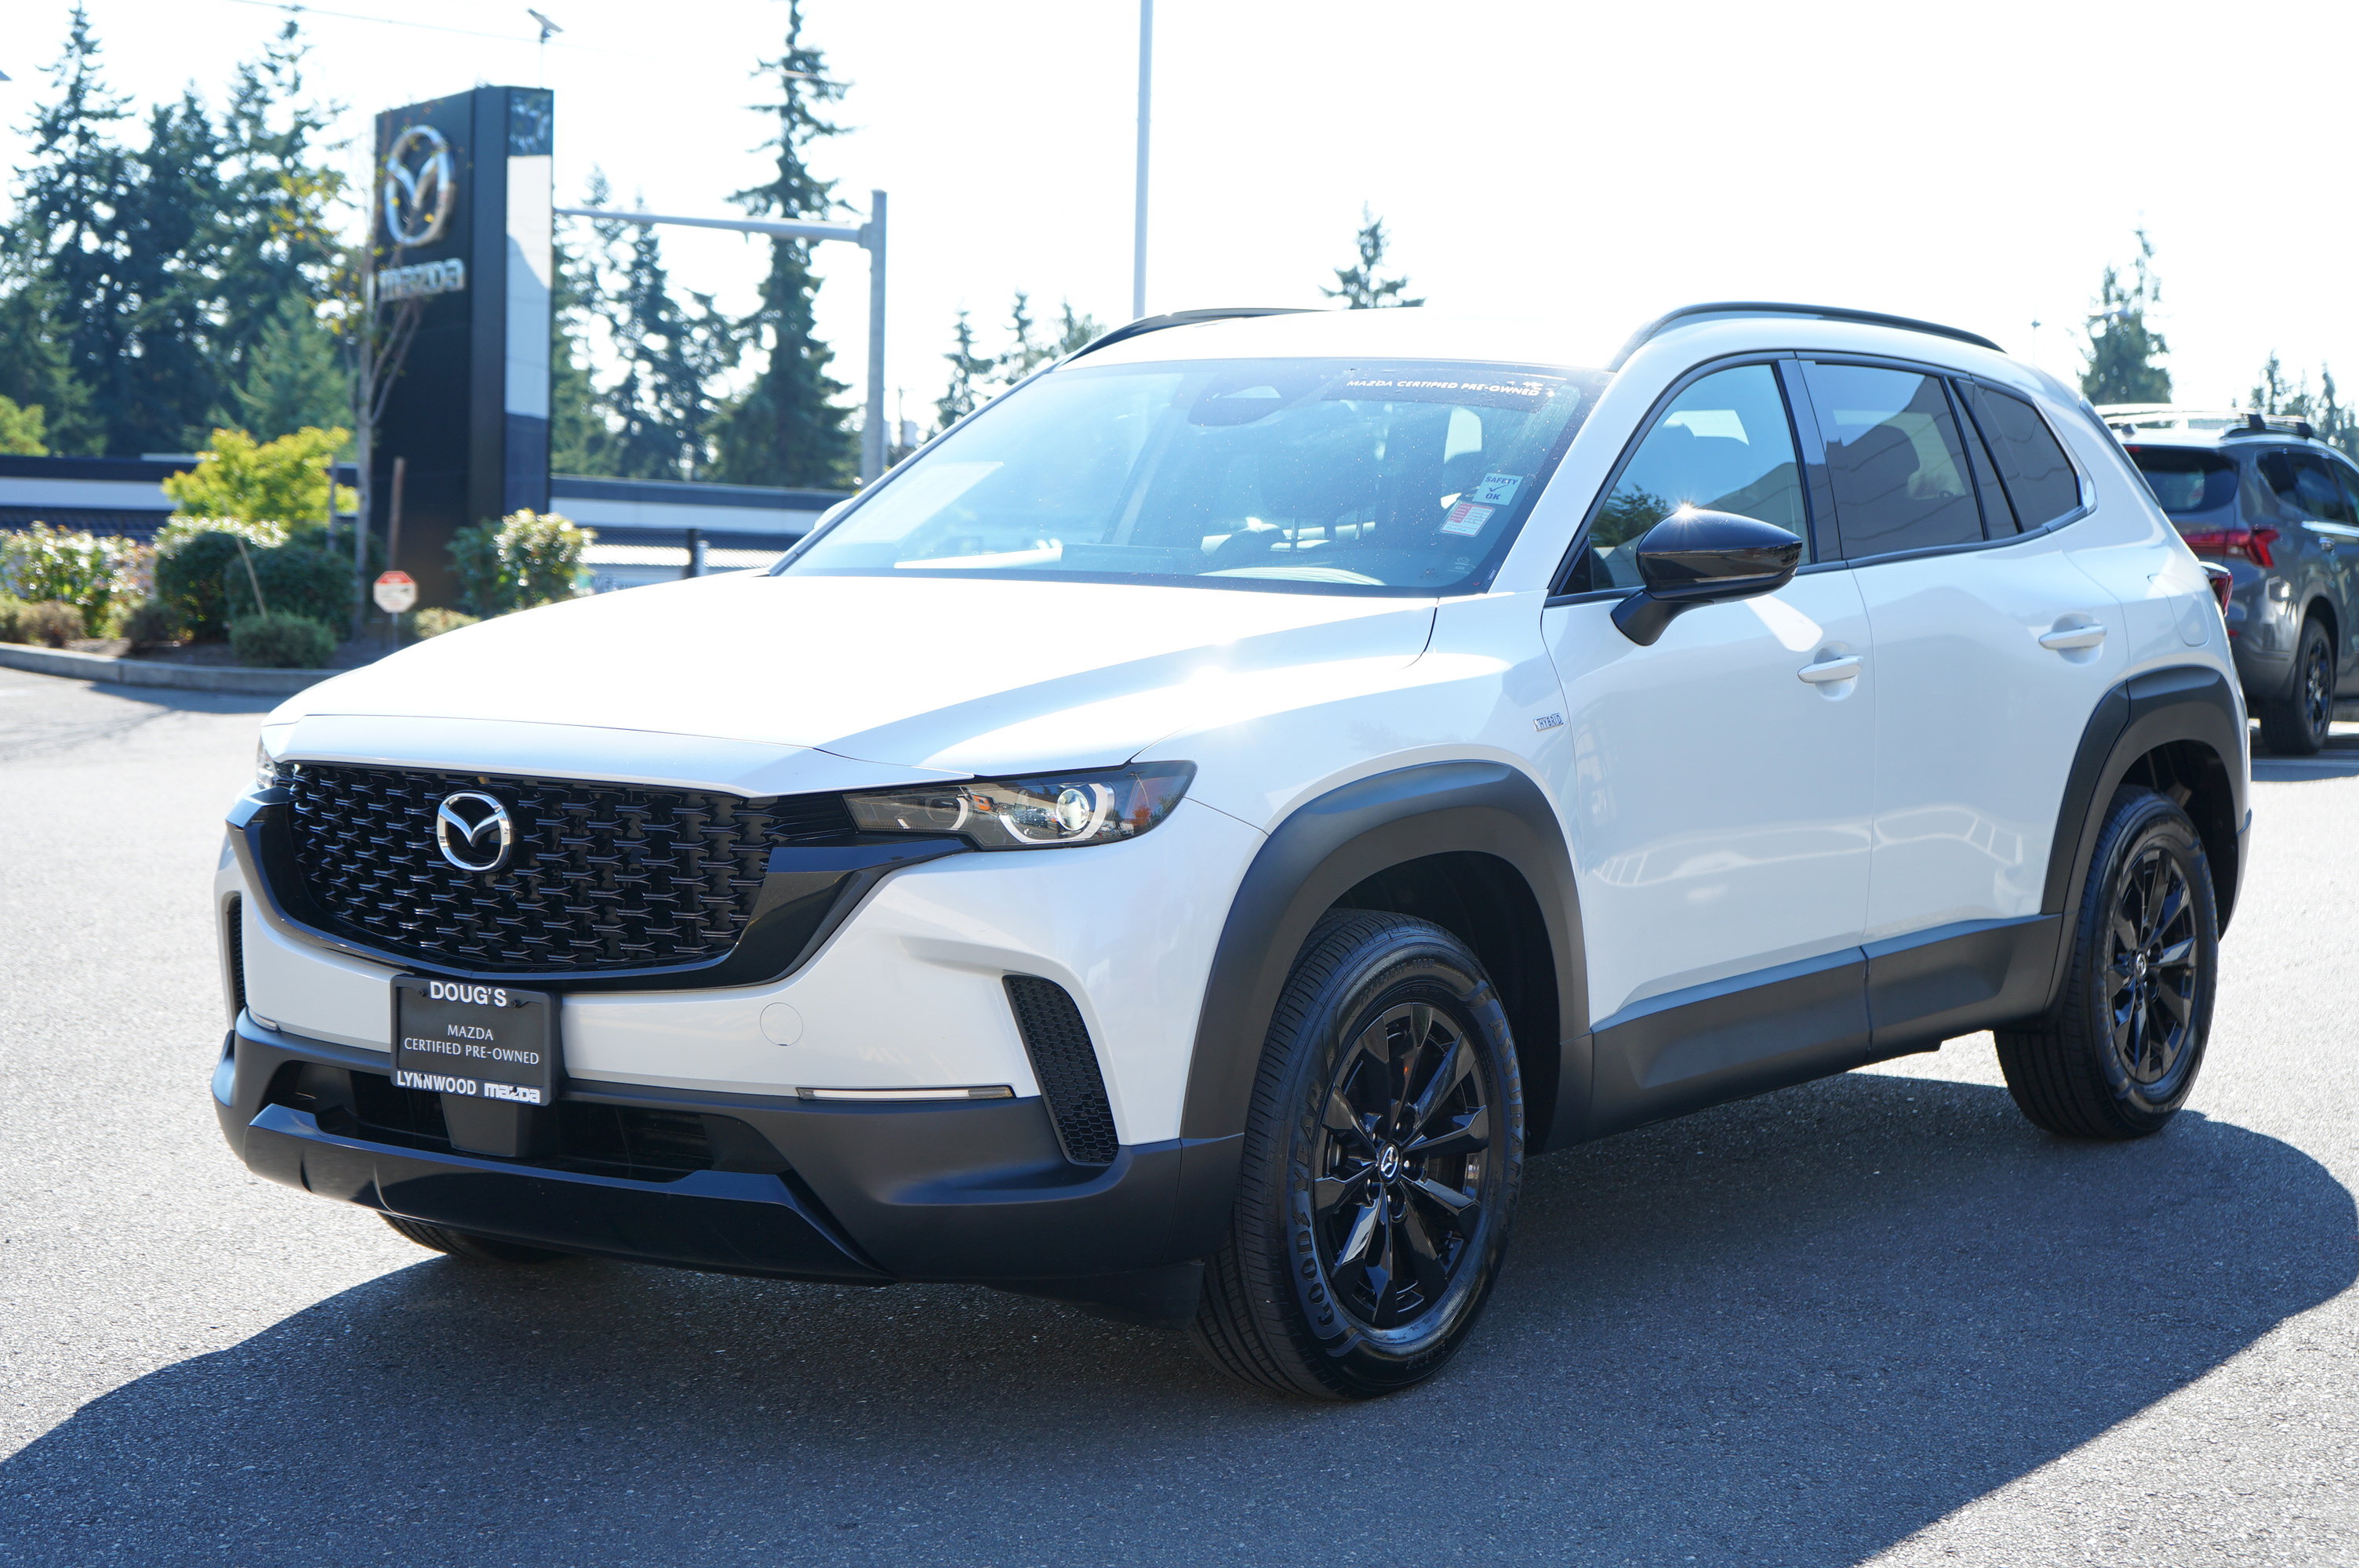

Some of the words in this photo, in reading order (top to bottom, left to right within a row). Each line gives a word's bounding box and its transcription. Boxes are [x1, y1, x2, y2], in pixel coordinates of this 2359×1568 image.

[1397, 380, 1459, 390] CERTIFIED
[1460, 382, 1540, 397] PRE-OWNED
[1485, 476, 1518, 485] SAFETY
[1539, 714, 1562, 728] HYBRID
[430, 981, 507, 1007] DOUG'S
[447, 1024, 494, 1041] MAZDA
[404, 1037, 461, 1055] CERTIFIED
[465, 1044, 540, 1065] PRE-OWNED
[397, 1070, 477, 1095] LYNNWOOD
[1293, 1079, 1335, 1327] GOODYEAR
